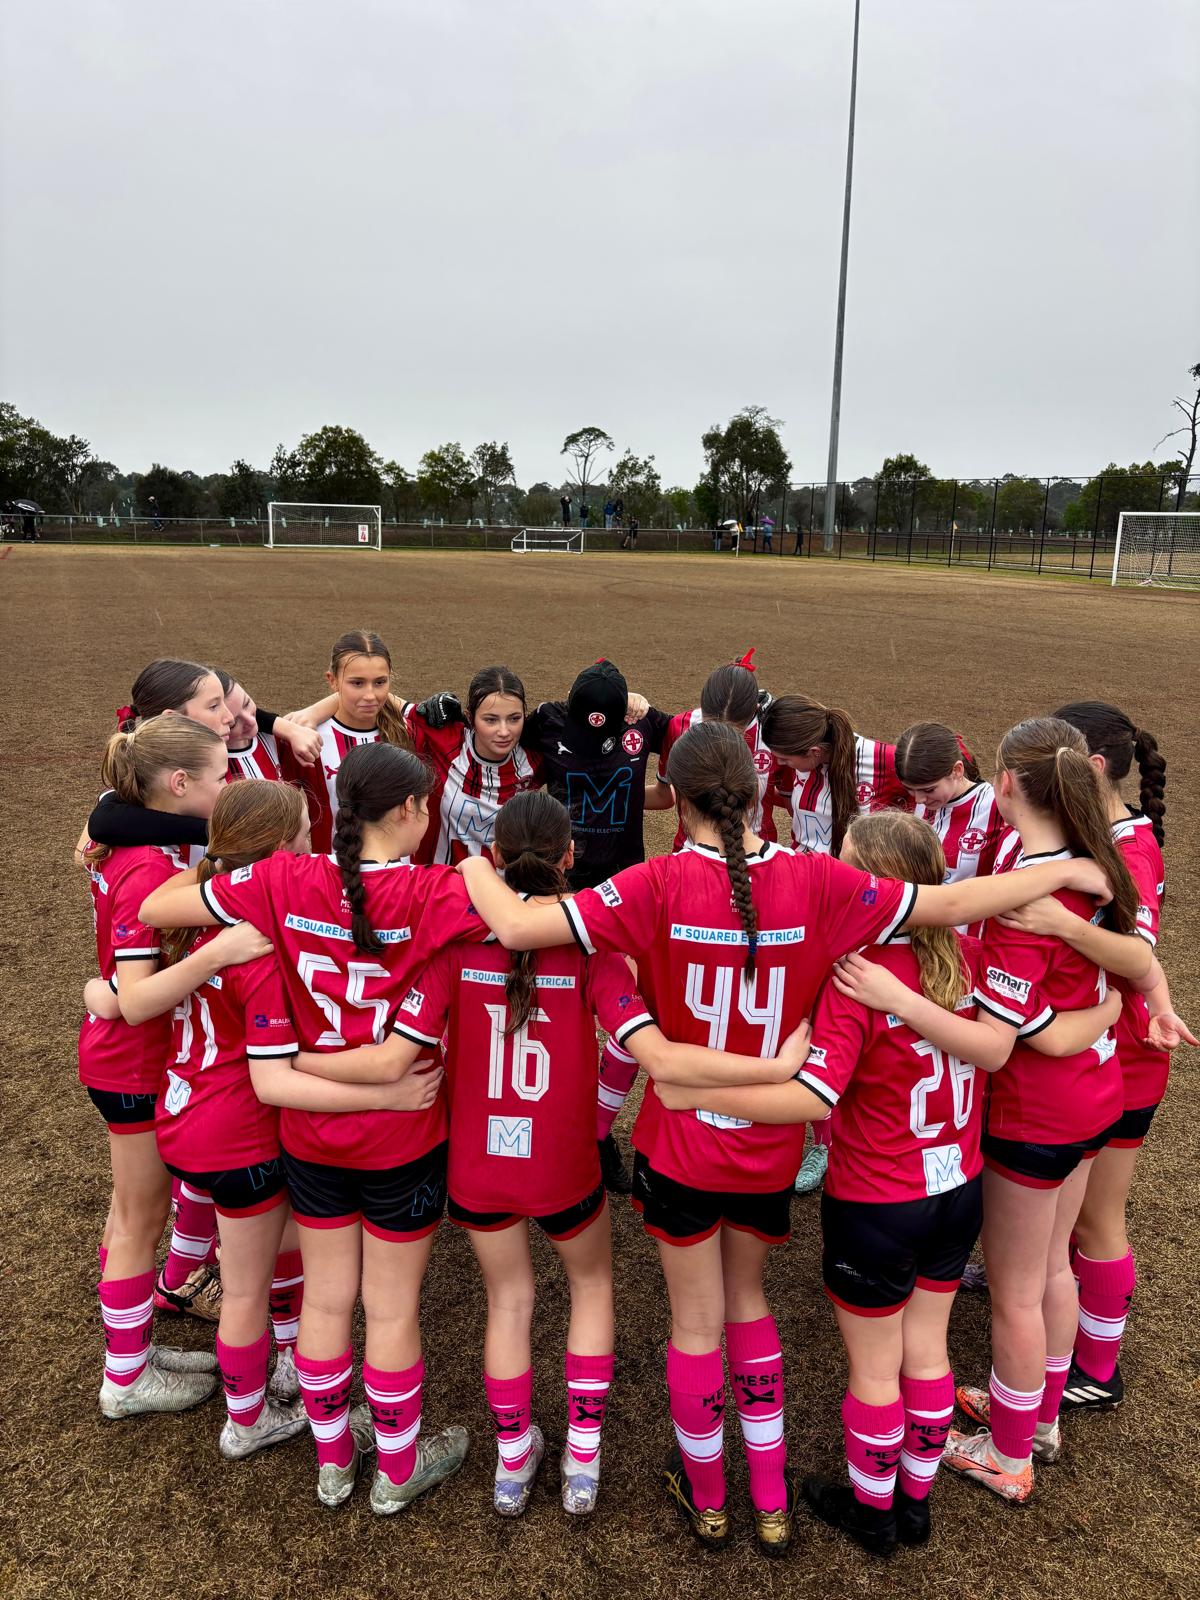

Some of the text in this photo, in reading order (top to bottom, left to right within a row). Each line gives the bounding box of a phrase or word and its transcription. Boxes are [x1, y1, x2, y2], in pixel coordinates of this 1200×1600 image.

[286, 916, 294, 926] M
[296, 919, 346, 938] SQUARED
[673, 927, 681, 936] M
[686, 928, 737, 942] SQUARED
[463, 970, 470, 978] M
[988, 969, 1030, 994] smart
[297, 951, 391, 1046] 55
[685, 963, 785, 1058] 44
[484, 1003, 551, 1101] 16
[910, 1039, 975, 1138] 26
[734, 1373, 778, 1386] MESC
